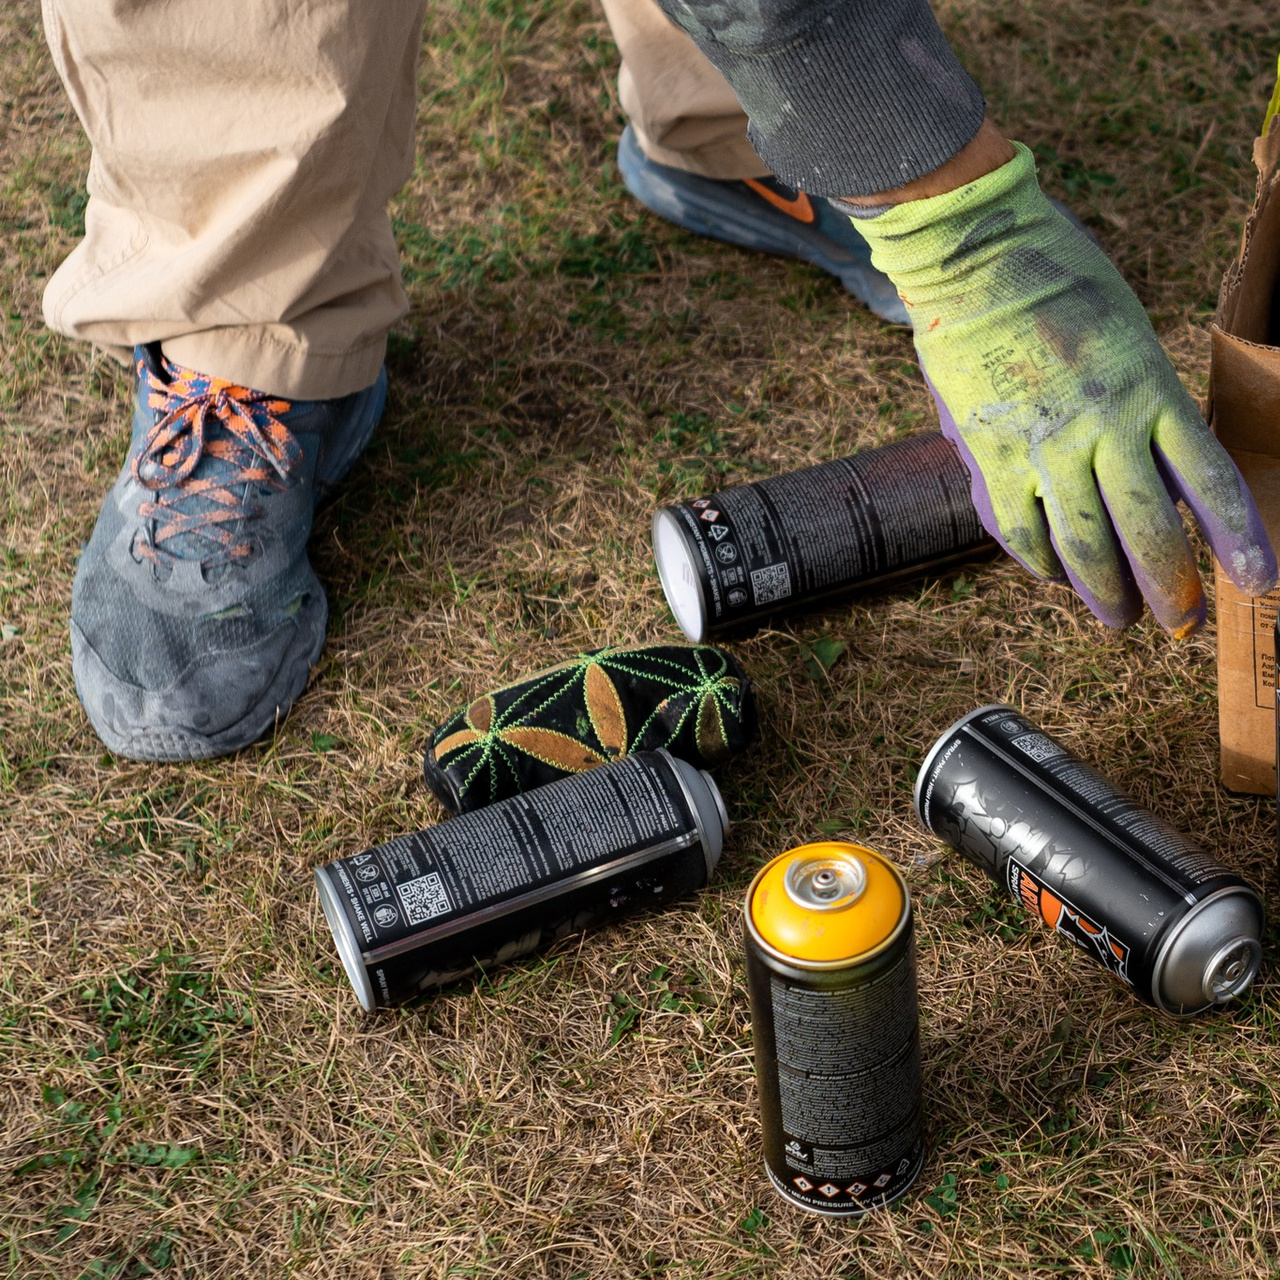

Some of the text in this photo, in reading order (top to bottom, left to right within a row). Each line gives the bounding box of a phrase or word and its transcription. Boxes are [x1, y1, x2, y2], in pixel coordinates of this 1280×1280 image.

[683, 513, 702, 540] RESISTANT
[697, 540, 713, 574] PIGMENTS
[709, 578, 719, 600] SHAKE
[925, 738, 961, 798] SPRAY PAINT HIGH
[1011, 864, 1019, 894] SPRAY
[1020, 871, 1039, 912] ART
[336, 867, 373, 943] PIGMENTS SHAKE WELL
[375, 968, 388, 988] SPRAY
[790, 1190, 811, 1203] MEAN
[812, 1199, 854, 1207] PRESSURE
